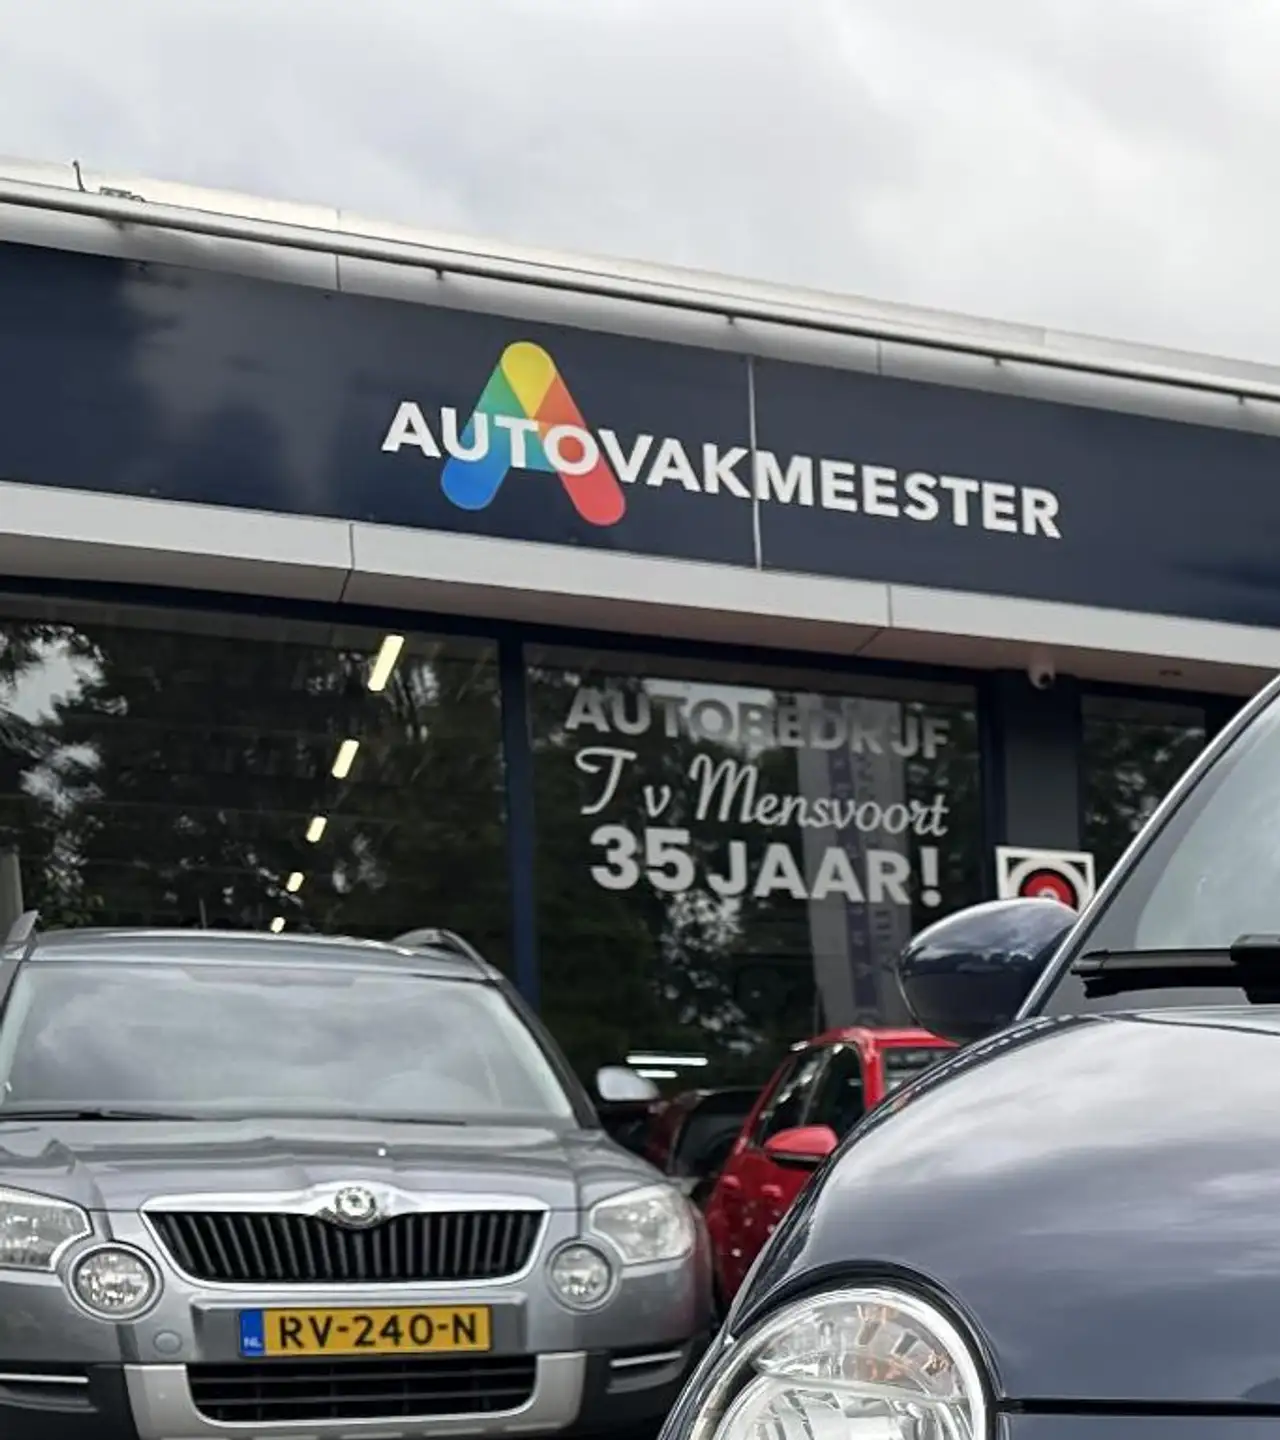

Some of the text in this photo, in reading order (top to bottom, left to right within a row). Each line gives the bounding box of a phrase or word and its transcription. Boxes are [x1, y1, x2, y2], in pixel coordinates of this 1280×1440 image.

[382, 401, 1062, 538] AUTOVAKMEESTER
[575, 746, 950, 837] T v Mensvoort
[590, 824, 942, 908] 35 JAAR!
[244, 1336, 262, 1348] NL
[278, 1313, 477, 1349] RV-240-N
